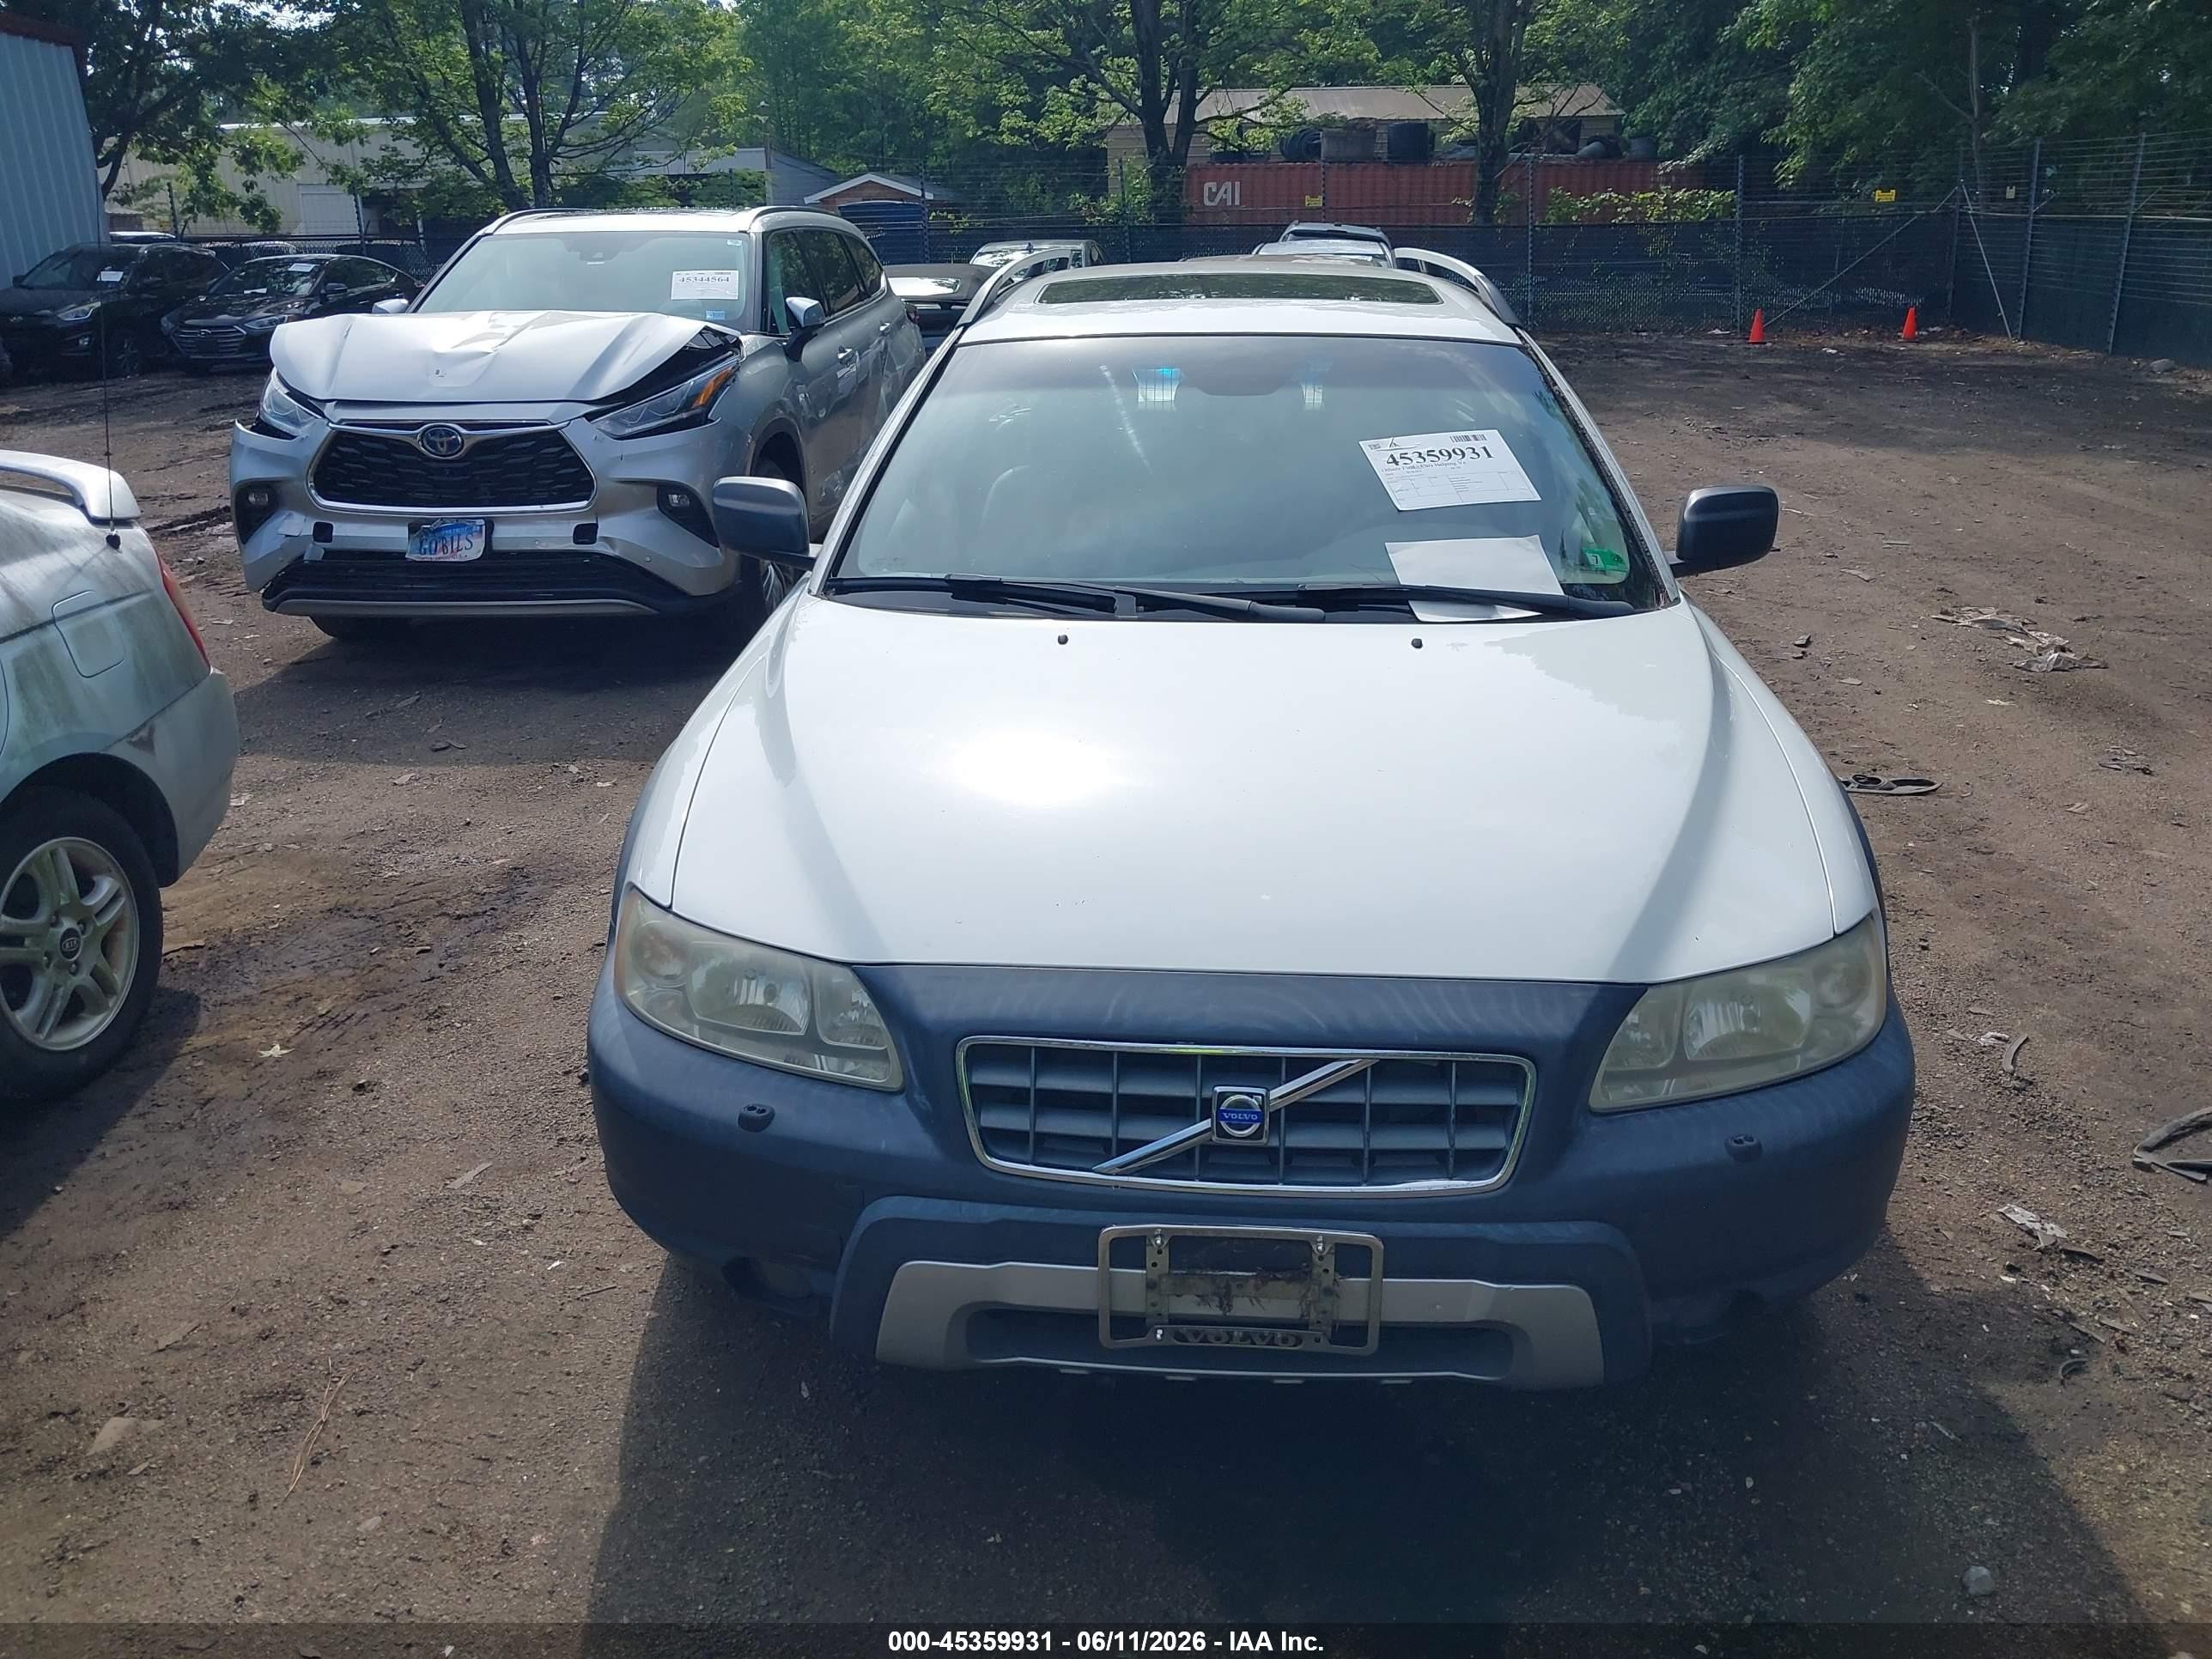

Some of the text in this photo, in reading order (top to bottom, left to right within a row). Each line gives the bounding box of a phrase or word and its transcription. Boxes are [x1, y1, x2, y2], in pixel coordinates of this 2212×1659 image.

[1203, 181, 1241, 207] CAI
[1386, 445, 1494, 466] 45359931
[1223, 1112, 1258, 1121] VOLVO
[1179, 1328, 1298, 1347] VOLVO
